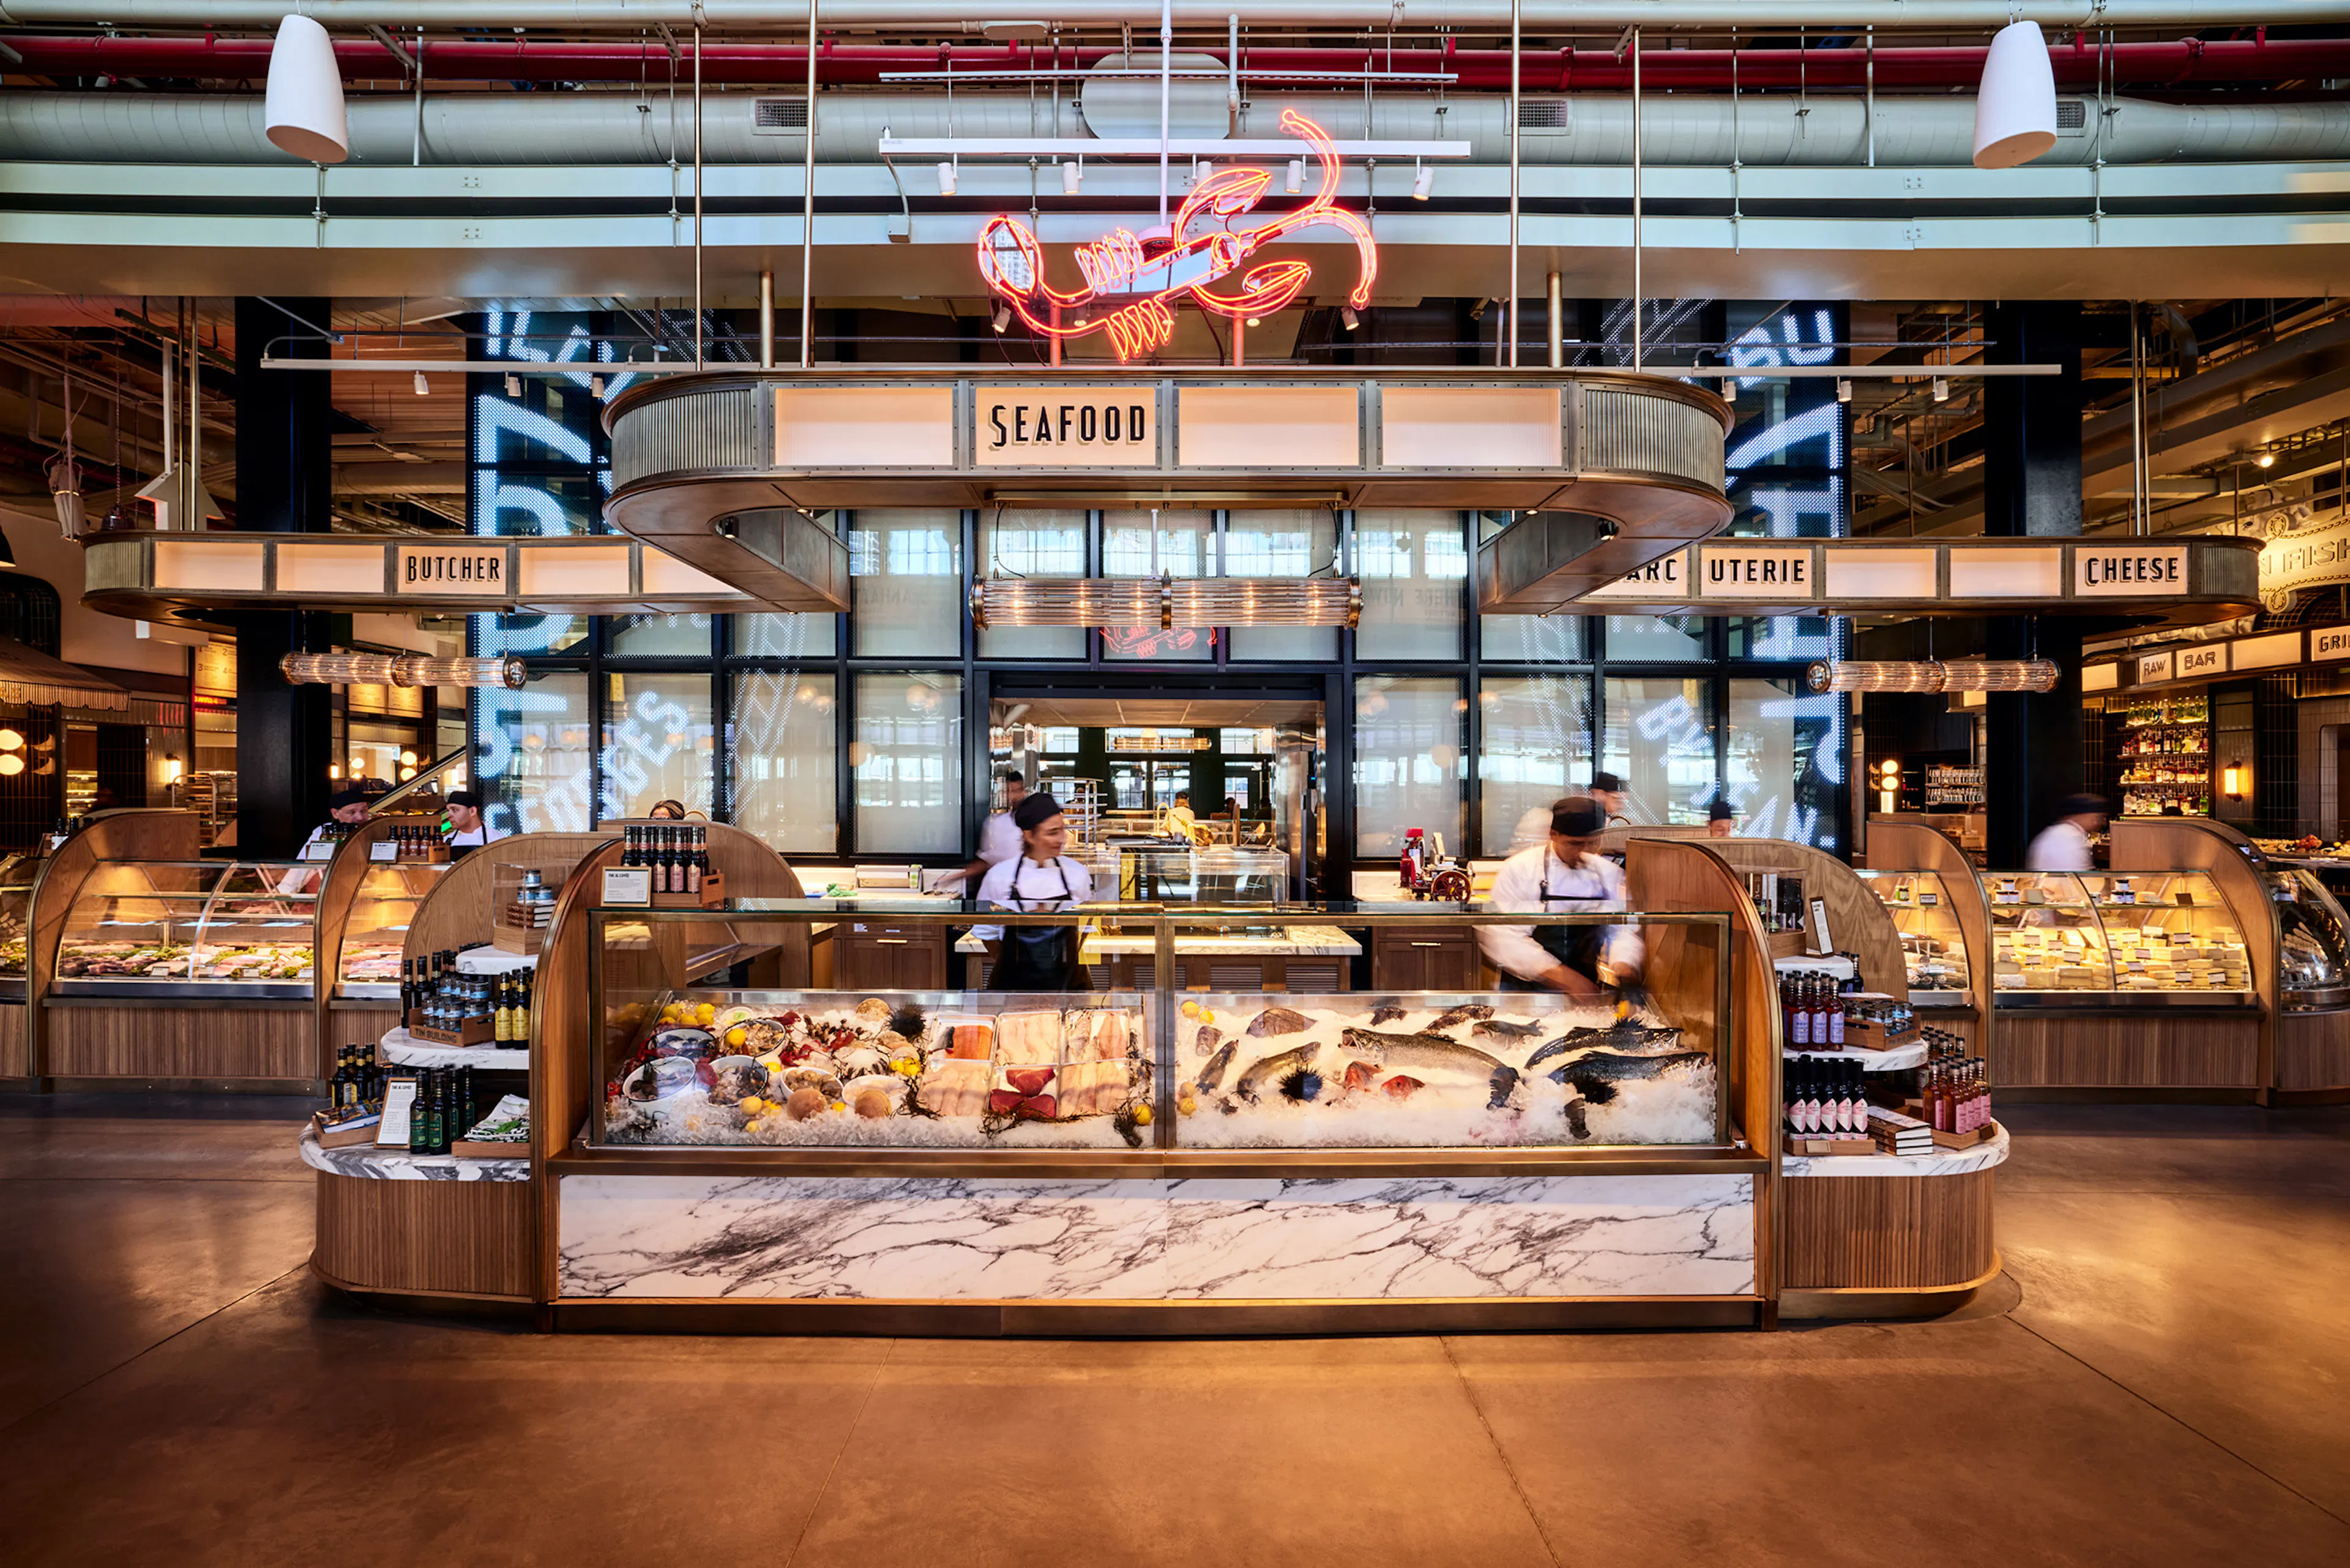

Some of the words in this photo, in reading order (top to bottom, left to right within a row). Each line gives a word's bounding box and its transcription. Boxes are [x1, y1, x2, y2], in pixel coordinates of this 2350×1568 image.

[989, 405, 1145, 450] SEAFOOD
[406, 556, 500, 583] BUTCHER
[1622, 558, 1677, 583] ARC
[1710, 558, 1805, 583] UTERIE
[2086, 558, 2179, 586] CHEESE
[2144, 660, 2166, 676] RAW
[2184, 651, 2216, 670] BAR
[415, 1028, 425, 1037] TIN
[427, 1030, 457, 1044] BUILDING
